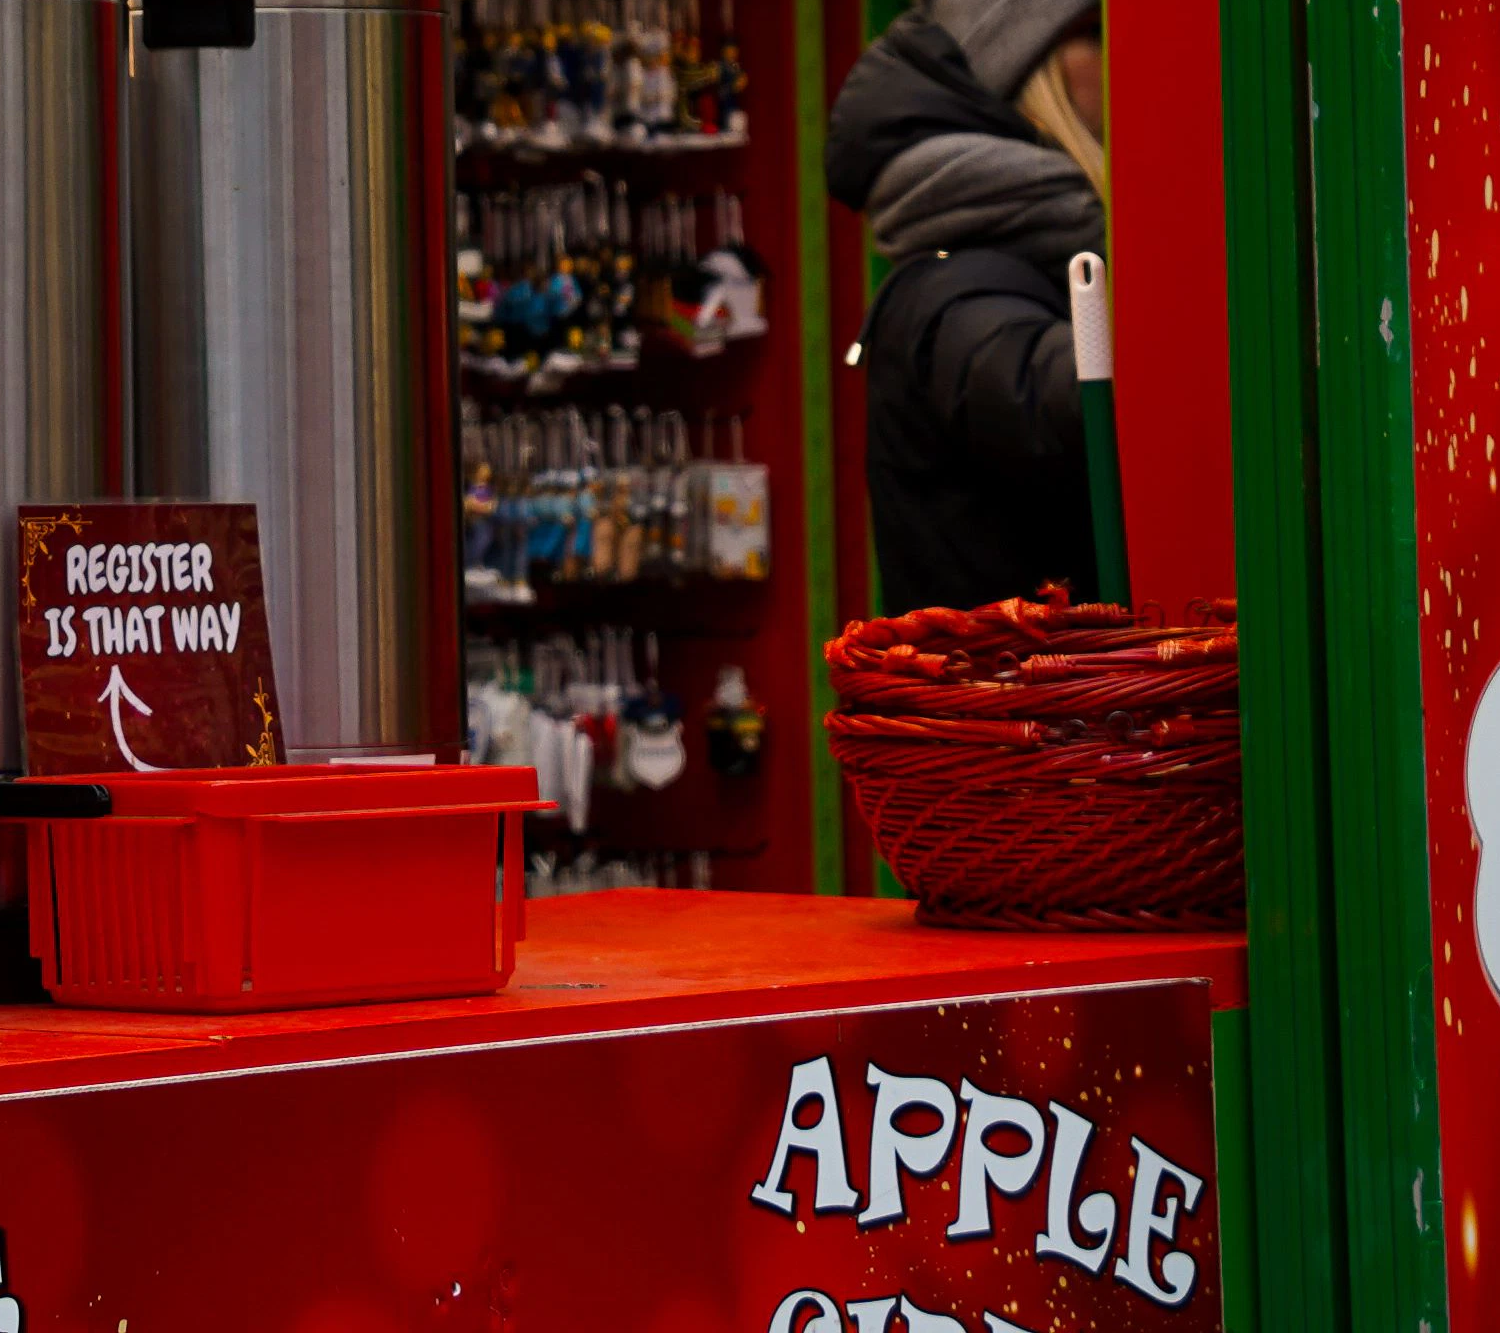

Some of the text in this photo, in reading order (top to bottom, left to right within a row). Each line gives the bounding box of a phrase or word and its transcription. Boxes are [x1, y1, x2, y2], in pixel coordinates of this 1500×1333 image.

[66, 542, 214, 595] REGISTER
[44, 601, 241, 657] IS THAT WAY
[751, 1056, 1203, 1306] APPLE
